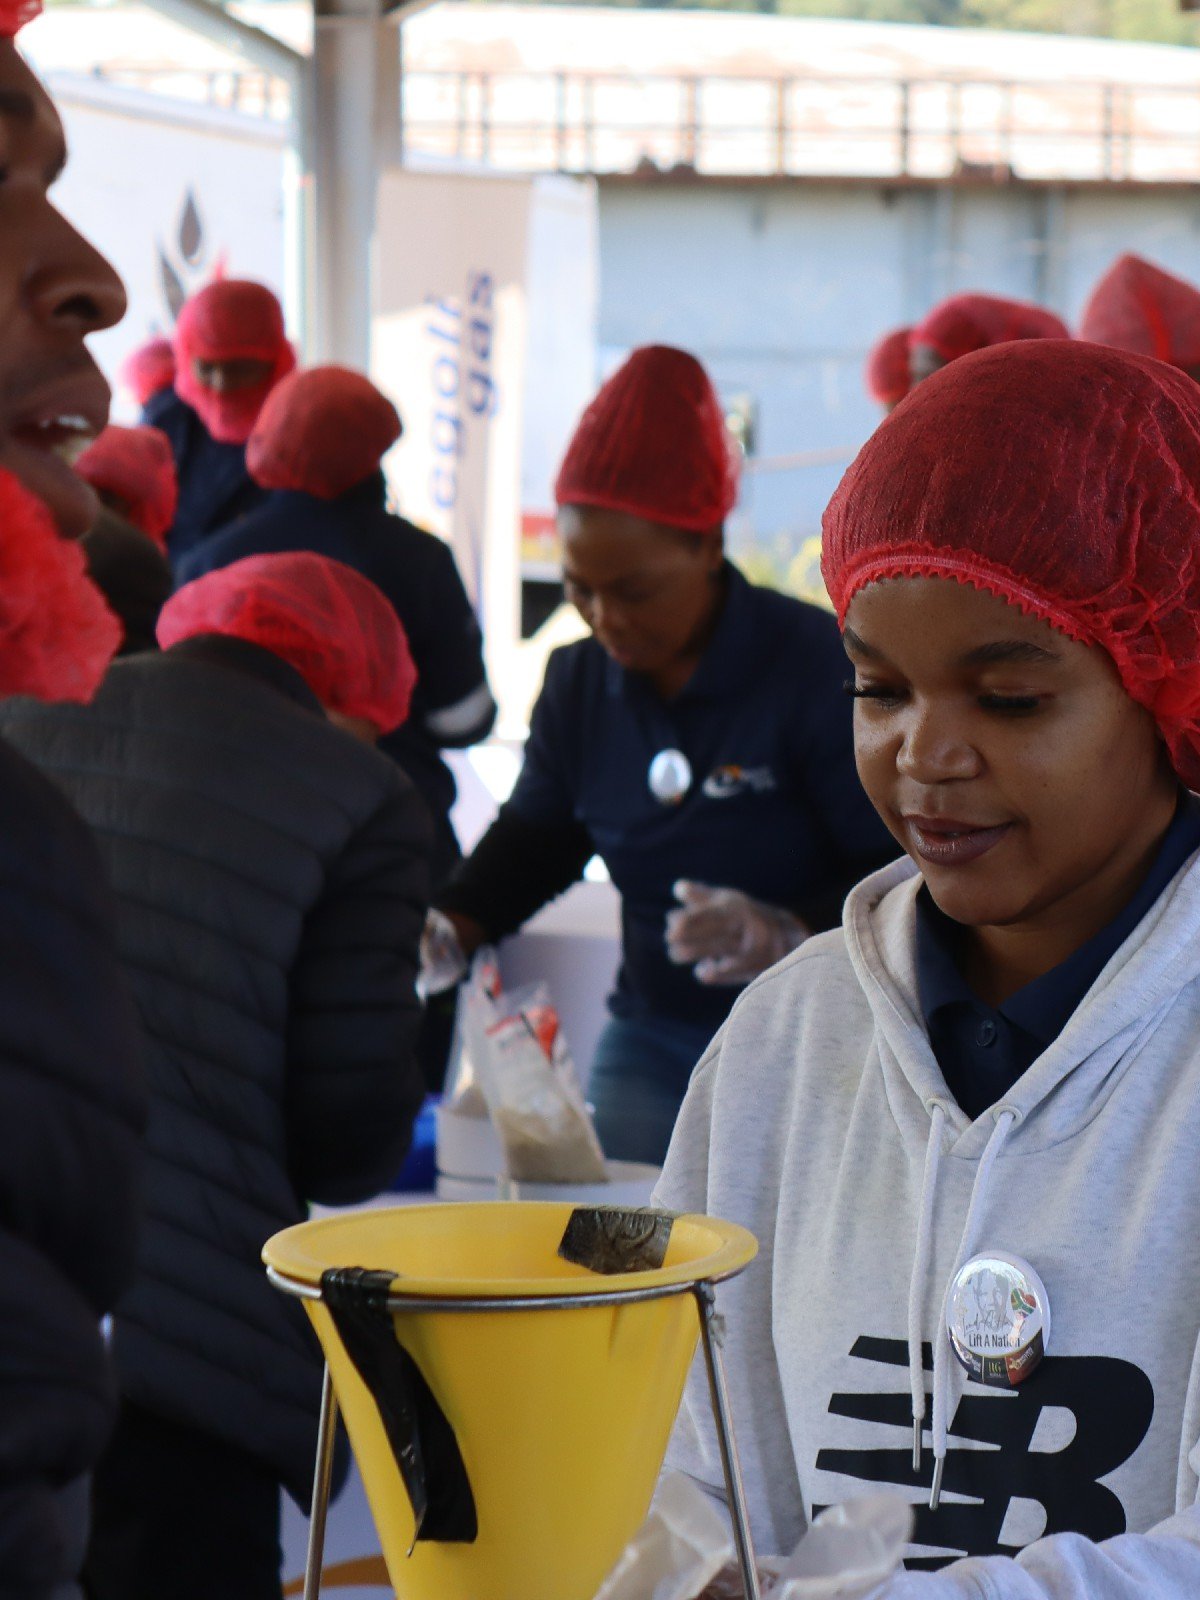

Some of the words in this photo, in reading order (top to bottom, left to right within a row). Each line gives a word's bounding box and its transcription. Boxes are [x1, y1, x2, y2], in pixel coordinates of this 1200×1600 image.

[467, 269, 499, 418] gas
[969, 1334, 982, 1347] Lift
[984, 1334, 991, 1347] A
